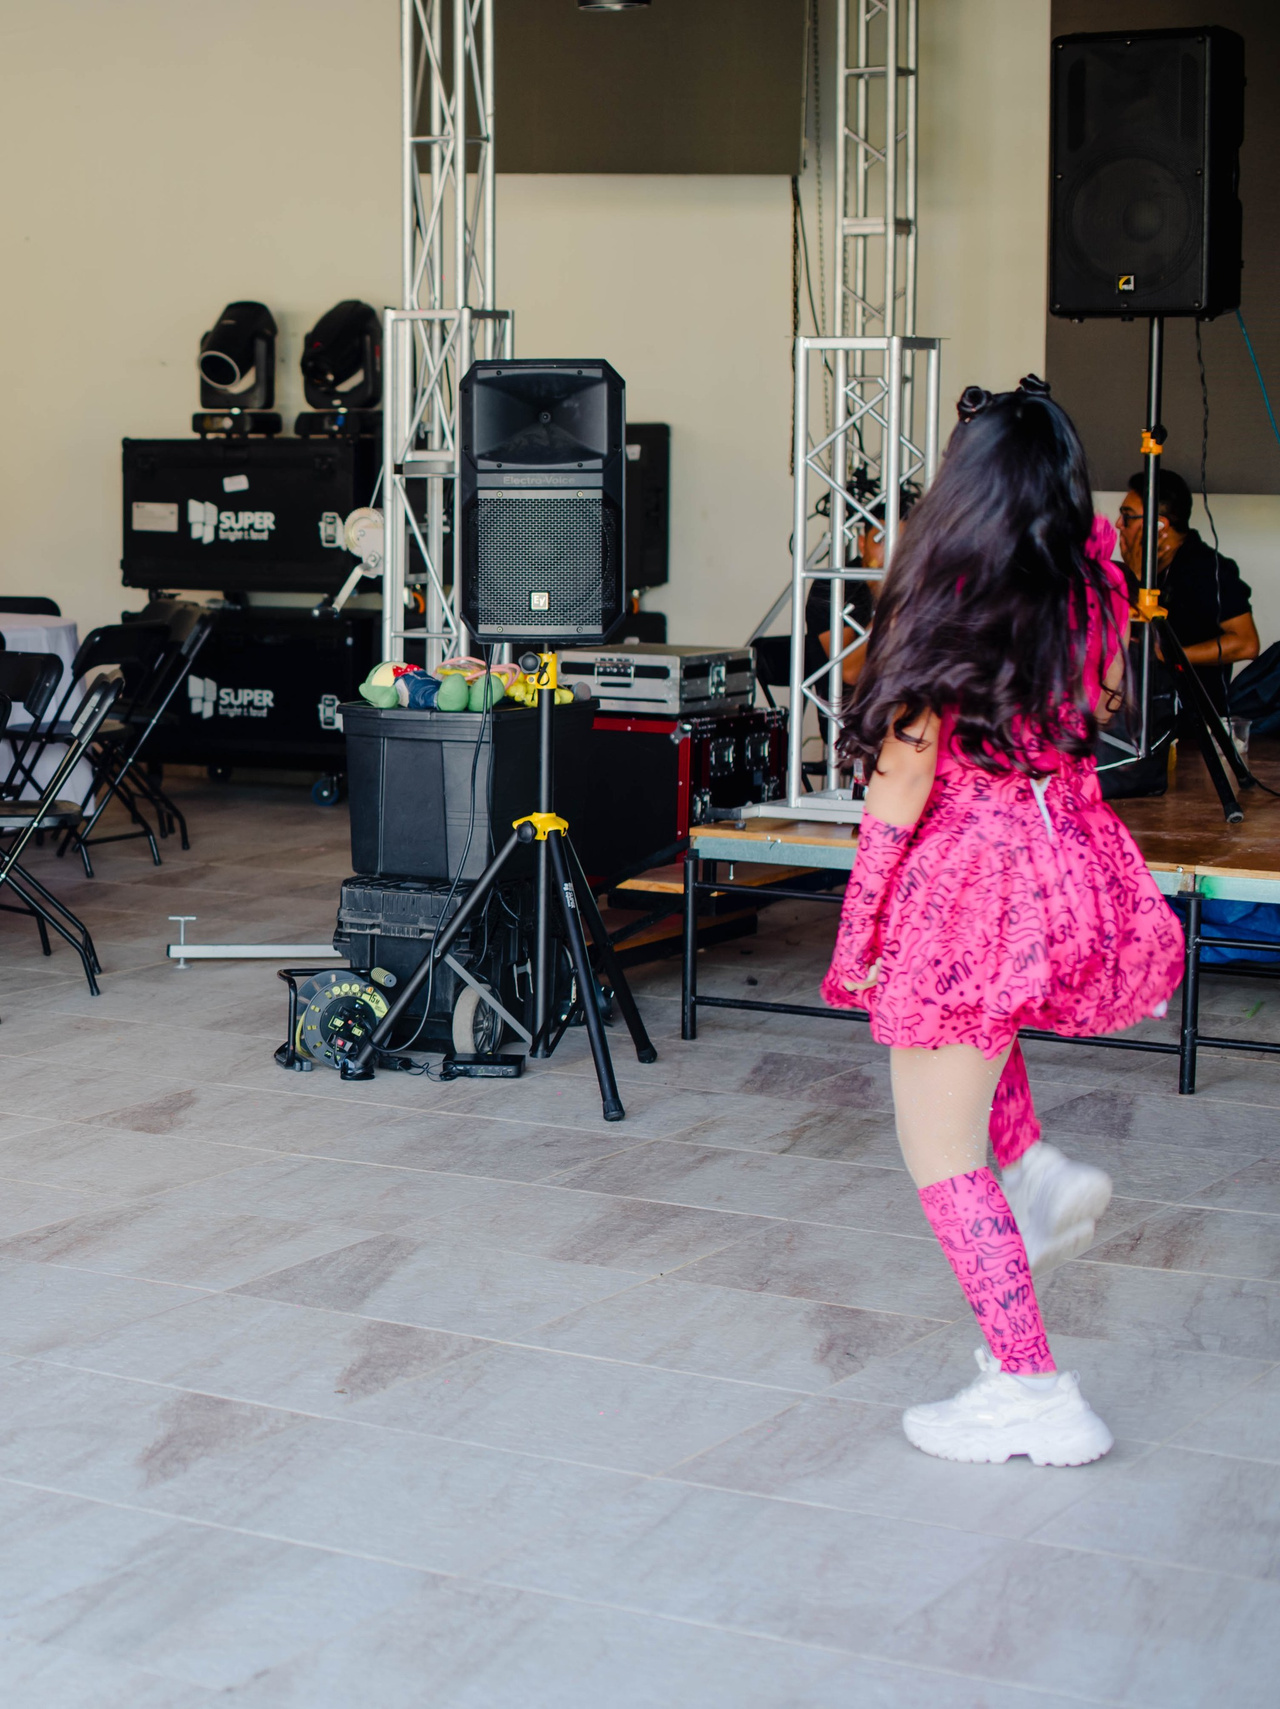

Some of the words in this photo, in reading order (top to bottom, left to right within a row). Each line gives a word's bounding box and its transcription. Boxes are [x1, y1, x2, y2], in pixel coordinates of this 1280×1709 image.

[219, 511, 276, 530] SUPER
[219, 688, 274, 707] SUPER
[935, 950, 973, 996] JUMP
